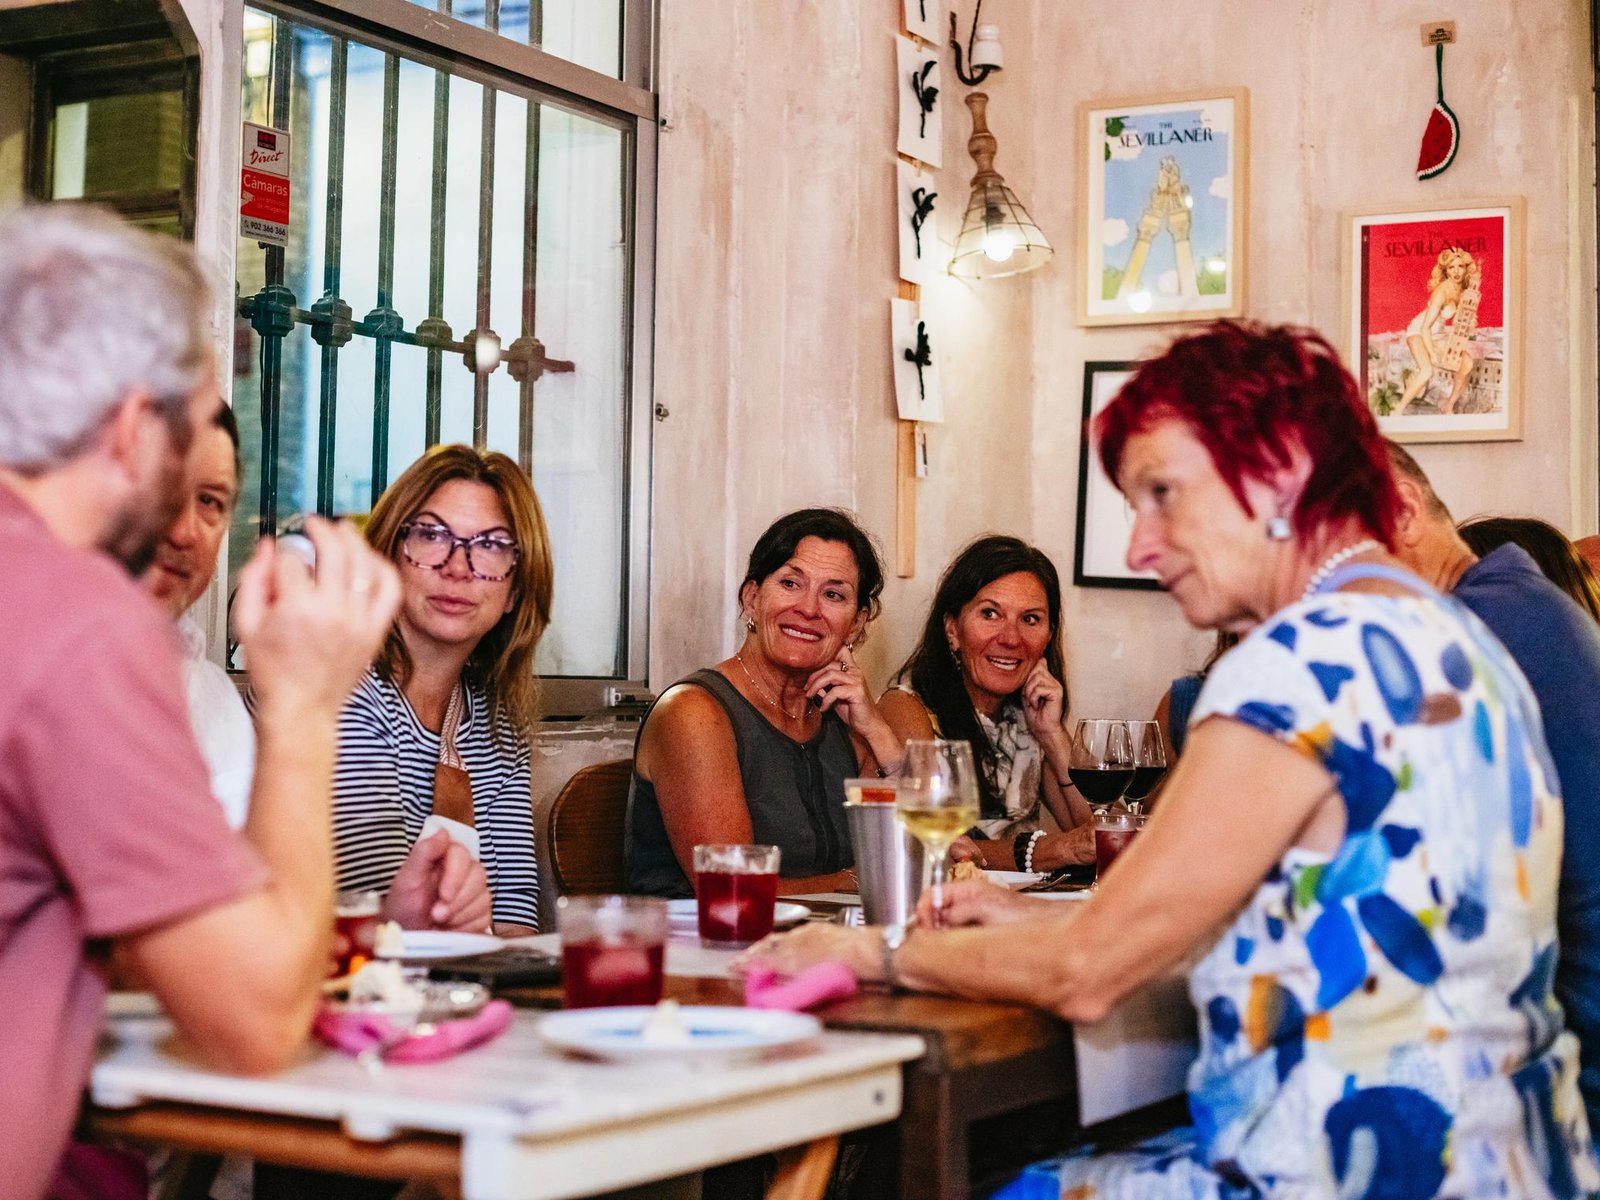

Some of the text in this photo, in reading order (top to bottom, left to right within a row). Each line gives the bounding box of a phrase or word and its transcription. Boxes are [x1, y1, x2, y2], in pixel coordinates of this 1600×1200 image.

[1118, 127, 1213, 149] SEVILLANER
[250, 148, 284, 165] Direct
[243, 174, 288, 197] Cámaras
[251, 221, 261, 231] 902
[263, 224, 274, 233] 366
[275, 226, 286, 236] 366
[1384, 237, 1487, 258] SEVILLANER
